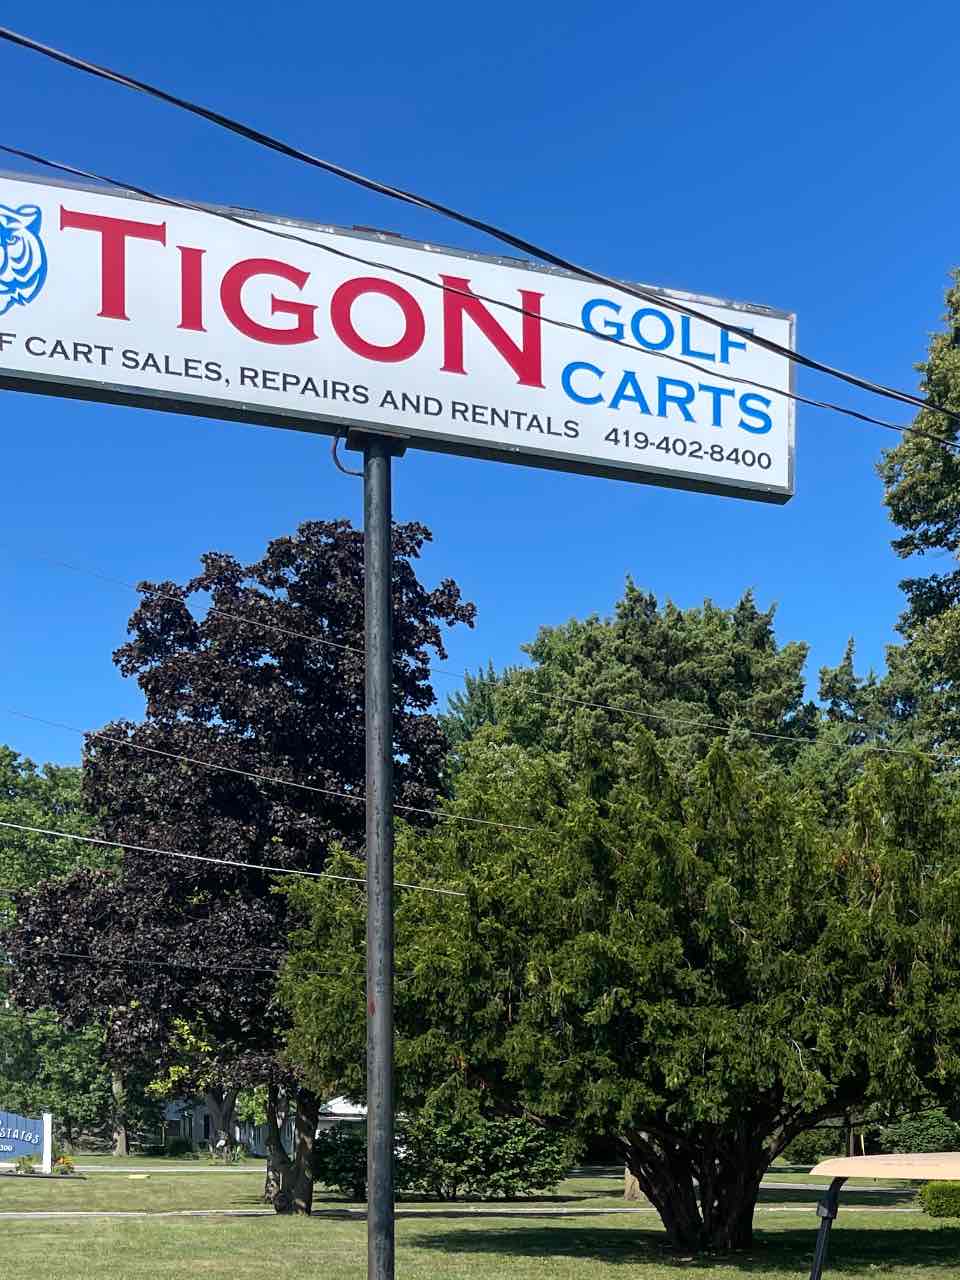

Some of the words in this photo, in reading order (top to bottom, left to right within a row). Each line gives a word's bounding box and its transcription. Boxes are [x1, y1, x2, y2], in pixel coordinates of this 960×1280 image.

[60, 203, 546, 389] TIGON
[580, 298, 755, 364] GOLF
[24, 336, 114, 366] CART
[121, 347, 231, 387] SALES,
[239, 365, 369, 405] REPAIRS
[379, 389, 443, 417] AND
[451, 401, 581, 439] RENTALS
[560, 360, 773, 435] CARTS
[603, 426, 773, 471] 419-402-8400
